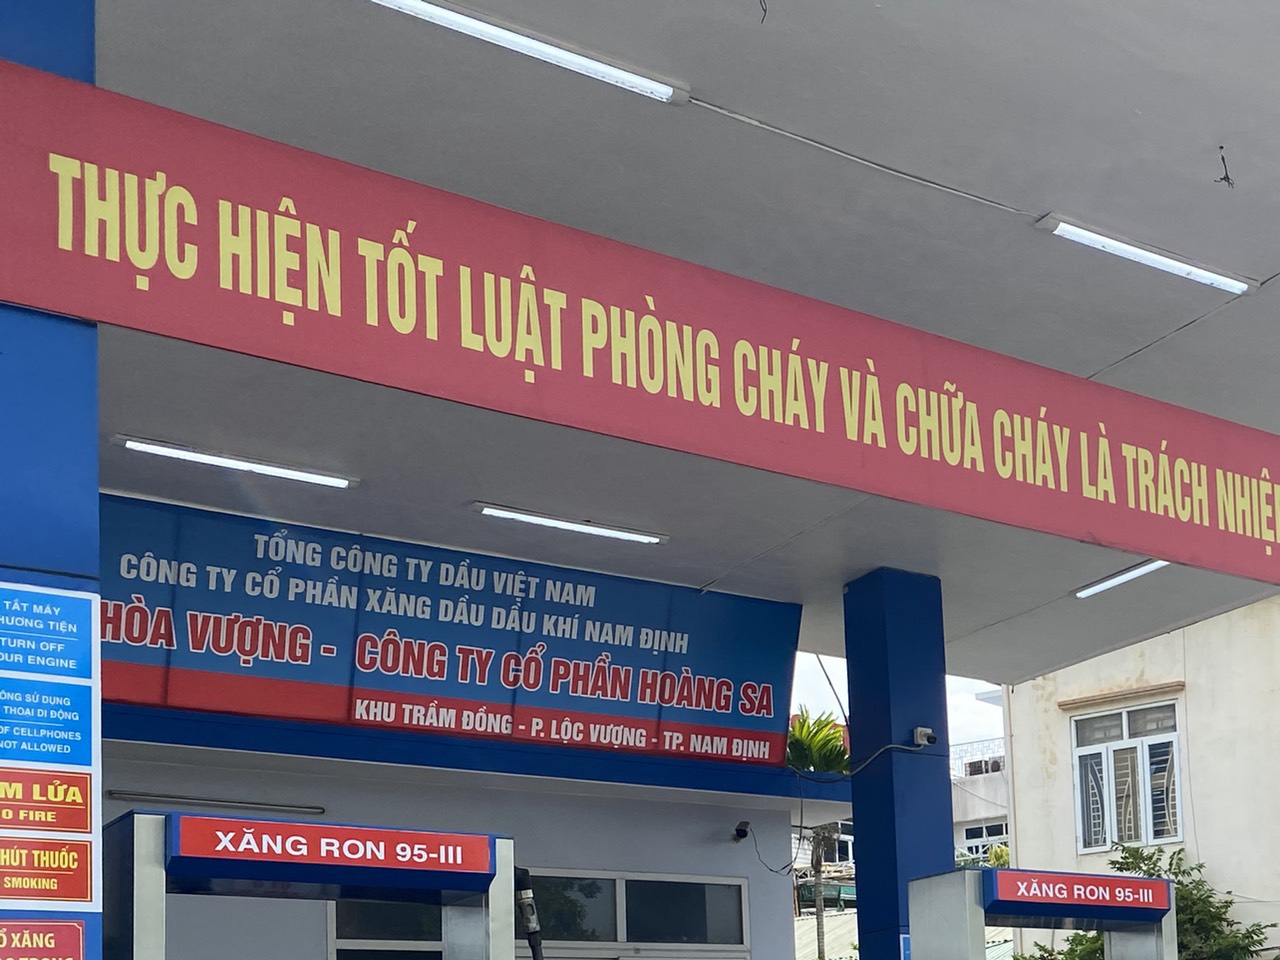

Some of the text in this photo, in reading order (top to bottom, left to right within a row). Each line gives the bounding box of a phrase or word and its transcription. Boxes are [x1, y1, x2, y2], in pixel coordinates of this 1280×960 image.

[48, 152, 199, 291] THỰC
[218, 197, 343, 326] HIỆN
[358, 220, 443, 341] TỐT
[459, 265, 567, 383] LUẬT
[581, 294, 721, 409] PHÒNG
[733, 339, 829, 434] CHÁY
[842, 358, 887, 449] VÀ
[896, 381, 984, 473] CHỮA
[993, 405, 1070, 492] CHÁY
[1079, 421, 1116, 504] LÀ
[1121, 439, 1210, 527] TRÁCH
[254, 529, 596, 608] TỔNG CÔNG TY DẦU VIỆT NAM
[4, 598, 61, 616] TẤT MÁY
[119, 554, 690, 656] CÔNG TY CỔ PHẦN XĂNG DẦU DẦU KHÍ NAM ĐỊNH
[0, 616, 77, 633] HƯƠNG TIỆN
[0, 637, 65, 653] TURN OFF
[0, 652, 77, 669] OUR ENGINE
[101, 594, 774, 719] HÒA VƯỢNG CÔNG TY CỔ PHẦN HOÀNG SA
[37, 708, 48, 718] DI
[13, 726, 82, 741] CELLPHONES
[354, 698, 771, 763] KHU TRẦM ĐỒNG P. LỘC VƯỢNG TP. NAM ĐỊNH
[20, 741, 71, 754] ALLOWED
[32, 779, 84, 804] LỬA
[18, 809, 57, 822] FIRE
[215, 828, 463, 864] XĂNG RON 95-III
[31, 845, 79, 869] THUỐC
[3, 876, 58, 890] SMOKING
[1016, 878, 1153, 903] XĂNG RON 95-III
[11, 930, 56, 948] XĂNG
